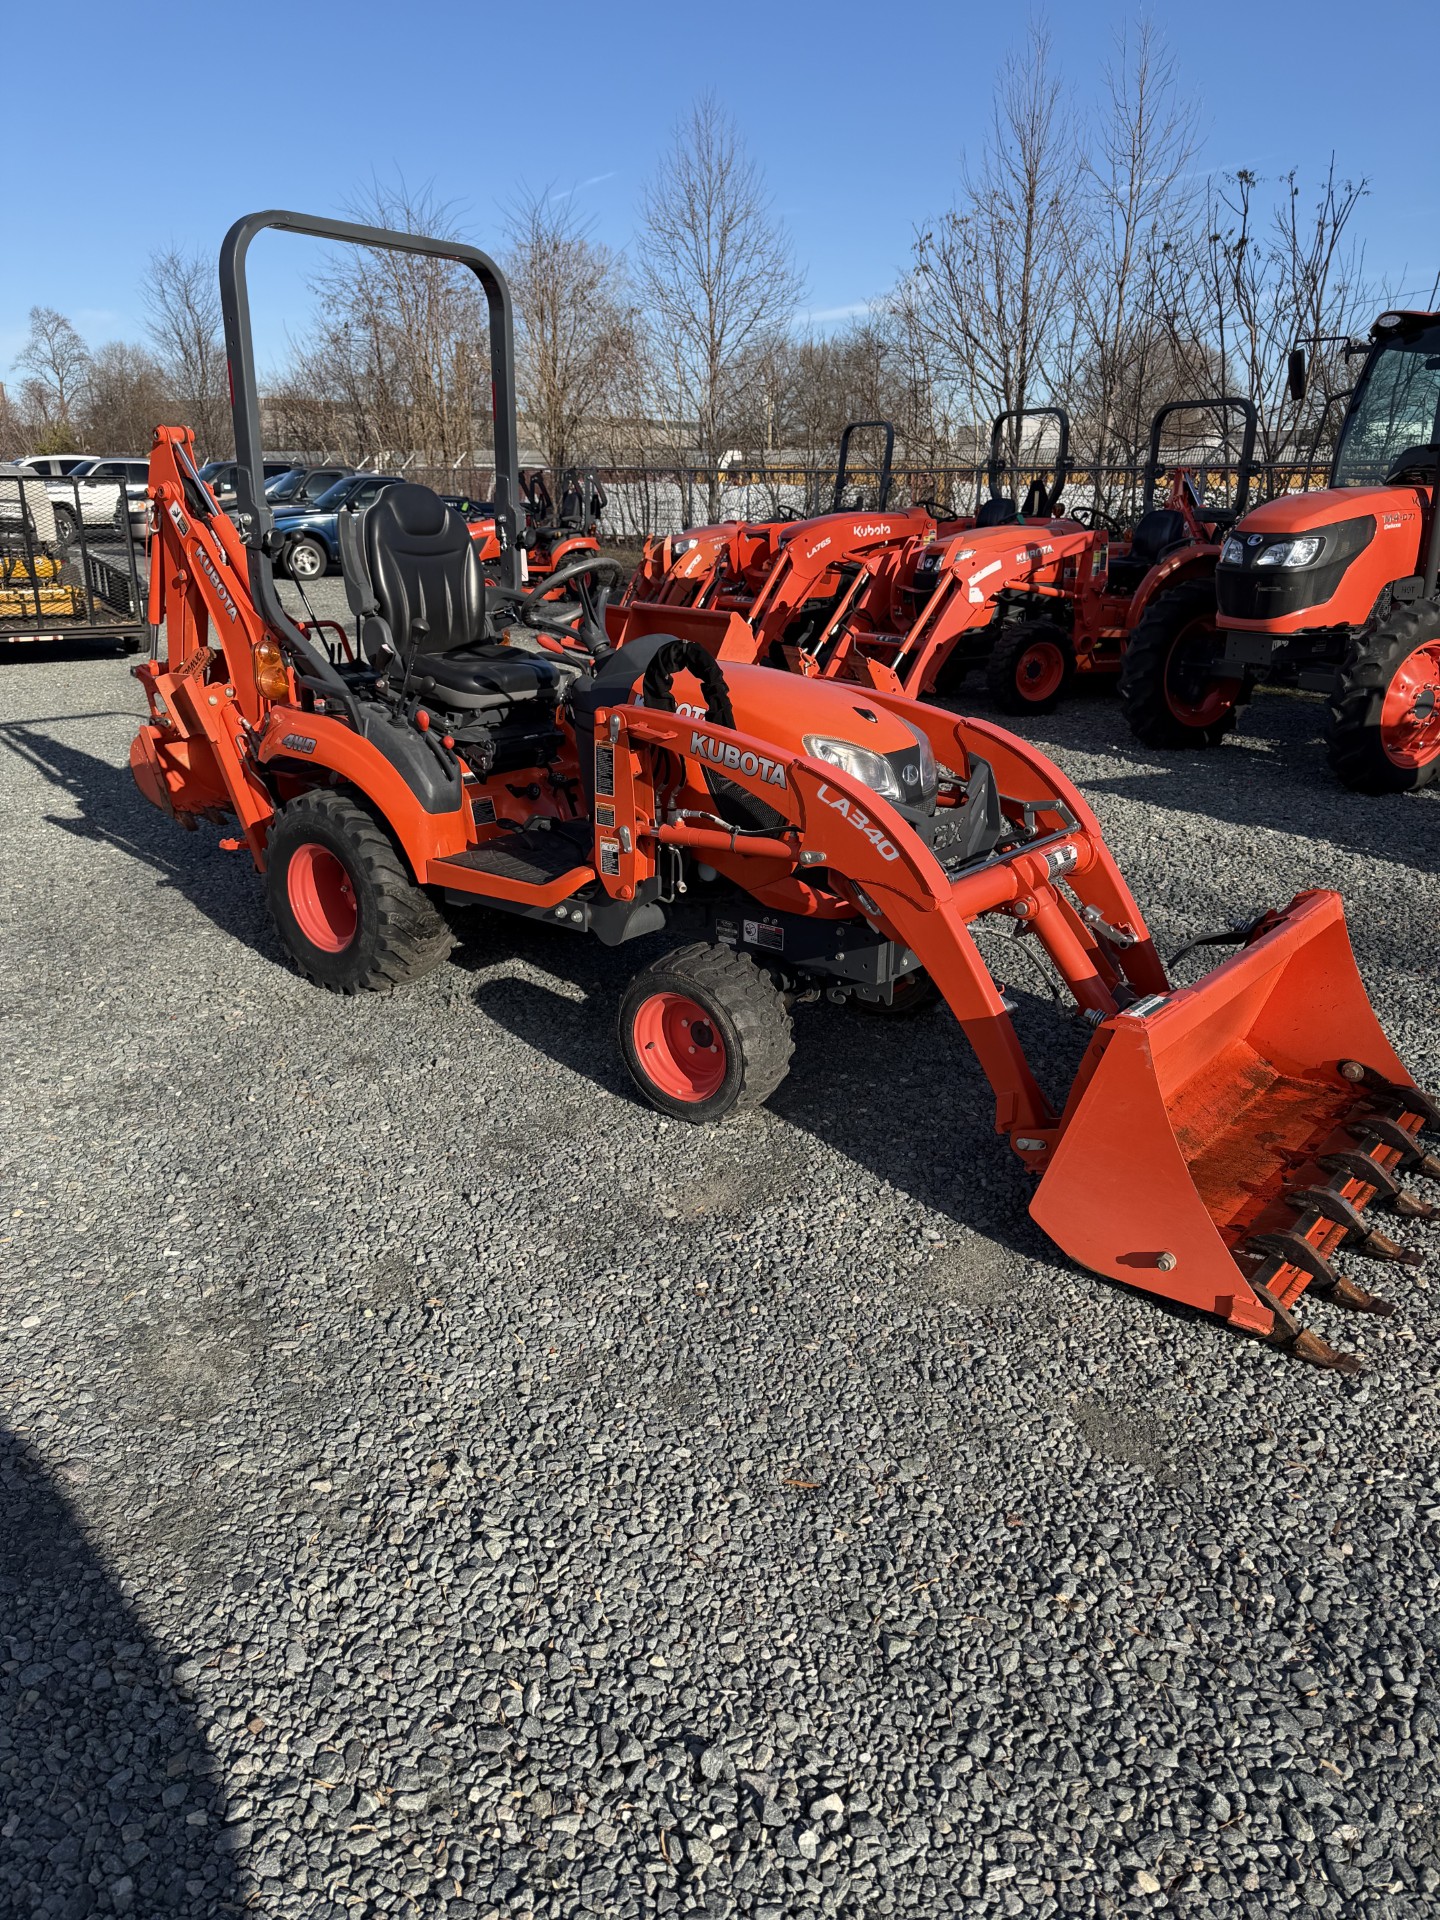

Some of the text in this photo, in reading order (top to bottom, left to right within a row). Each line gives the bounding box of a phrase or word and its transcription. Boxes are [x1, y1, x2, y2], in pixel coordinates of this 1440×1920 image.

[853, 523, 891, 537] Kubota
[806, 537, 831, 559] LA765
[1015, 545, 1054, 564] KUBOTA
[195, 545, 237, 624] KUBOTA
[281, 733, 317, 754] 4WD
[689, 731, 788, 790] KUBOTA
[816, 783, 900, 862] LA340
